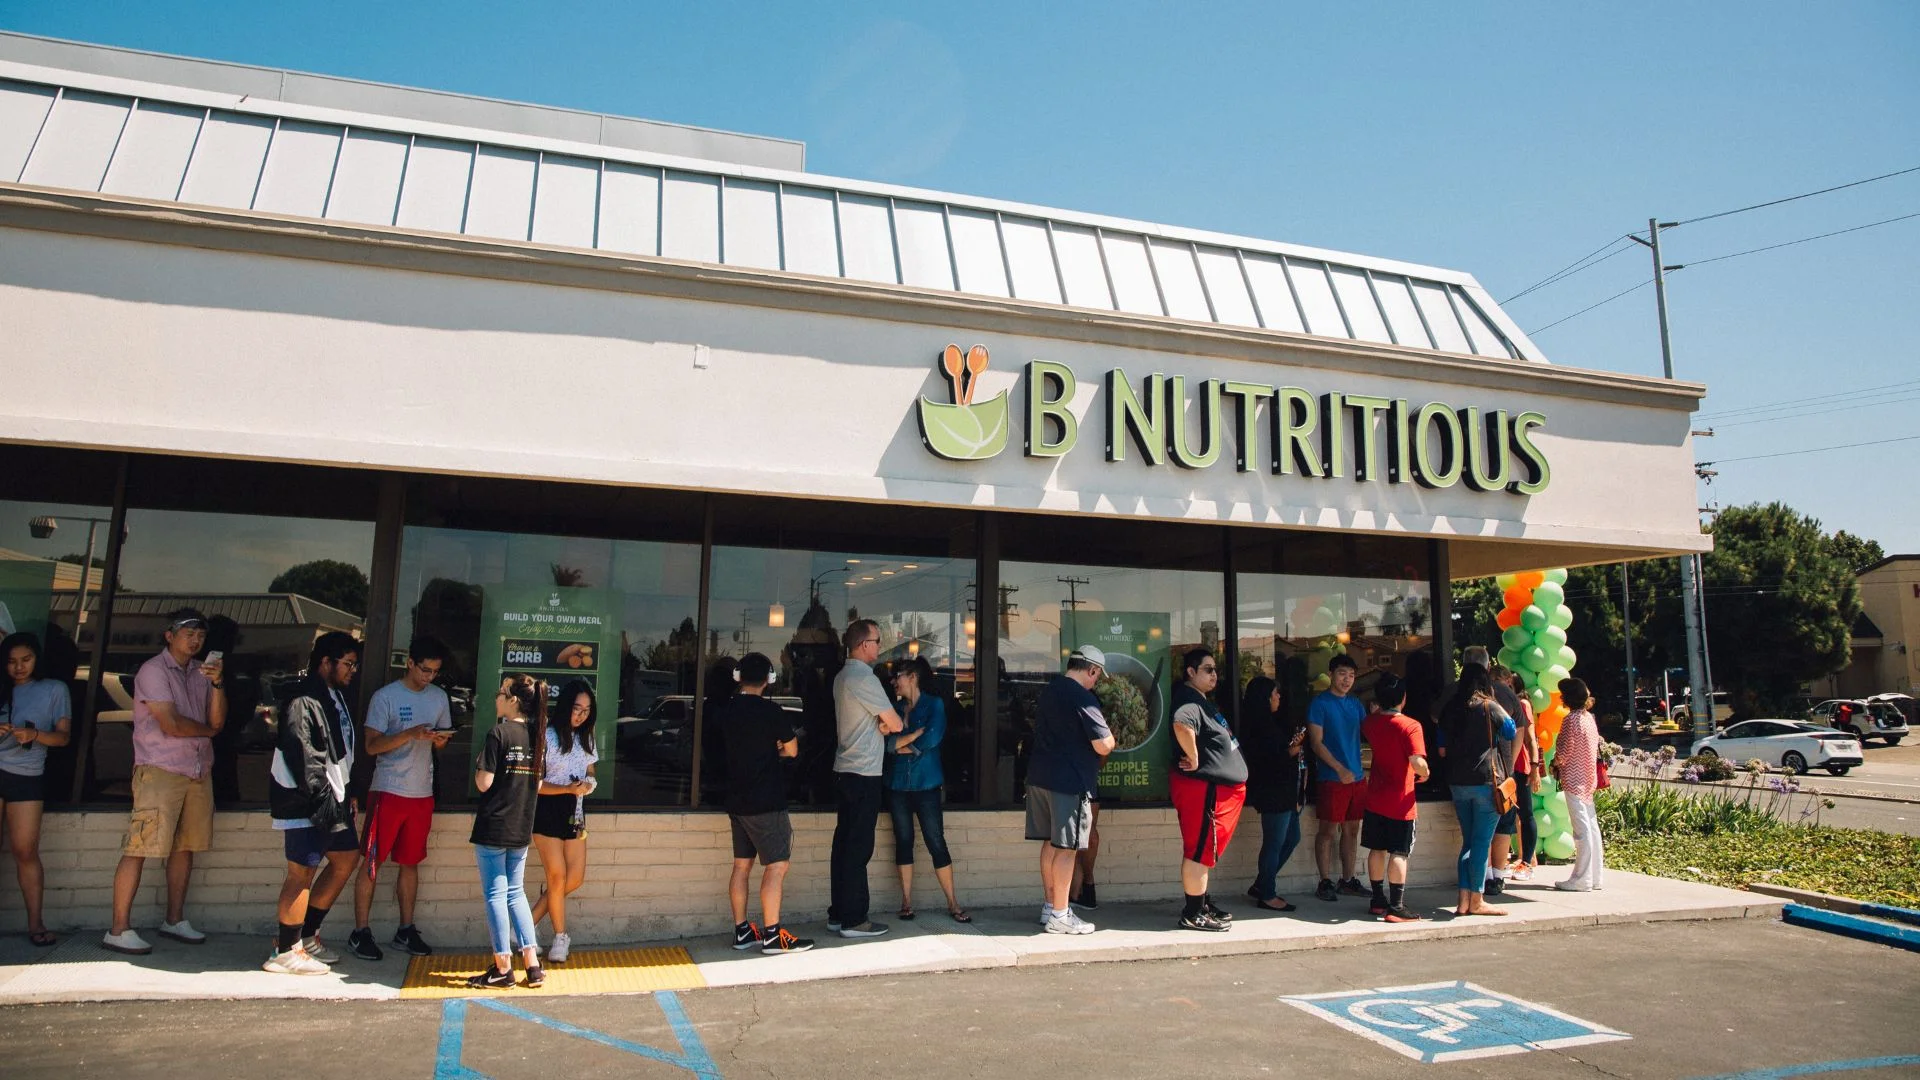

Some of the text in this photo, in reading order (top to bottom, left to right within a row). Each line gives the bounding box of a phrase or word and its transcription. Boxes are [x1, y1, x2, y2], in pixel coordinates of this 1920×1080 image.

[1025, 358, 1551, 496] B NUTRITIOUS
[503, 612, 602, 625] BUILD YOUR OWN MEAL
[518, 624, 543, 636] Enjoy
[506, 651, 542, 663] CARB
[1097, 774, 1149, 786] RIED RICE
